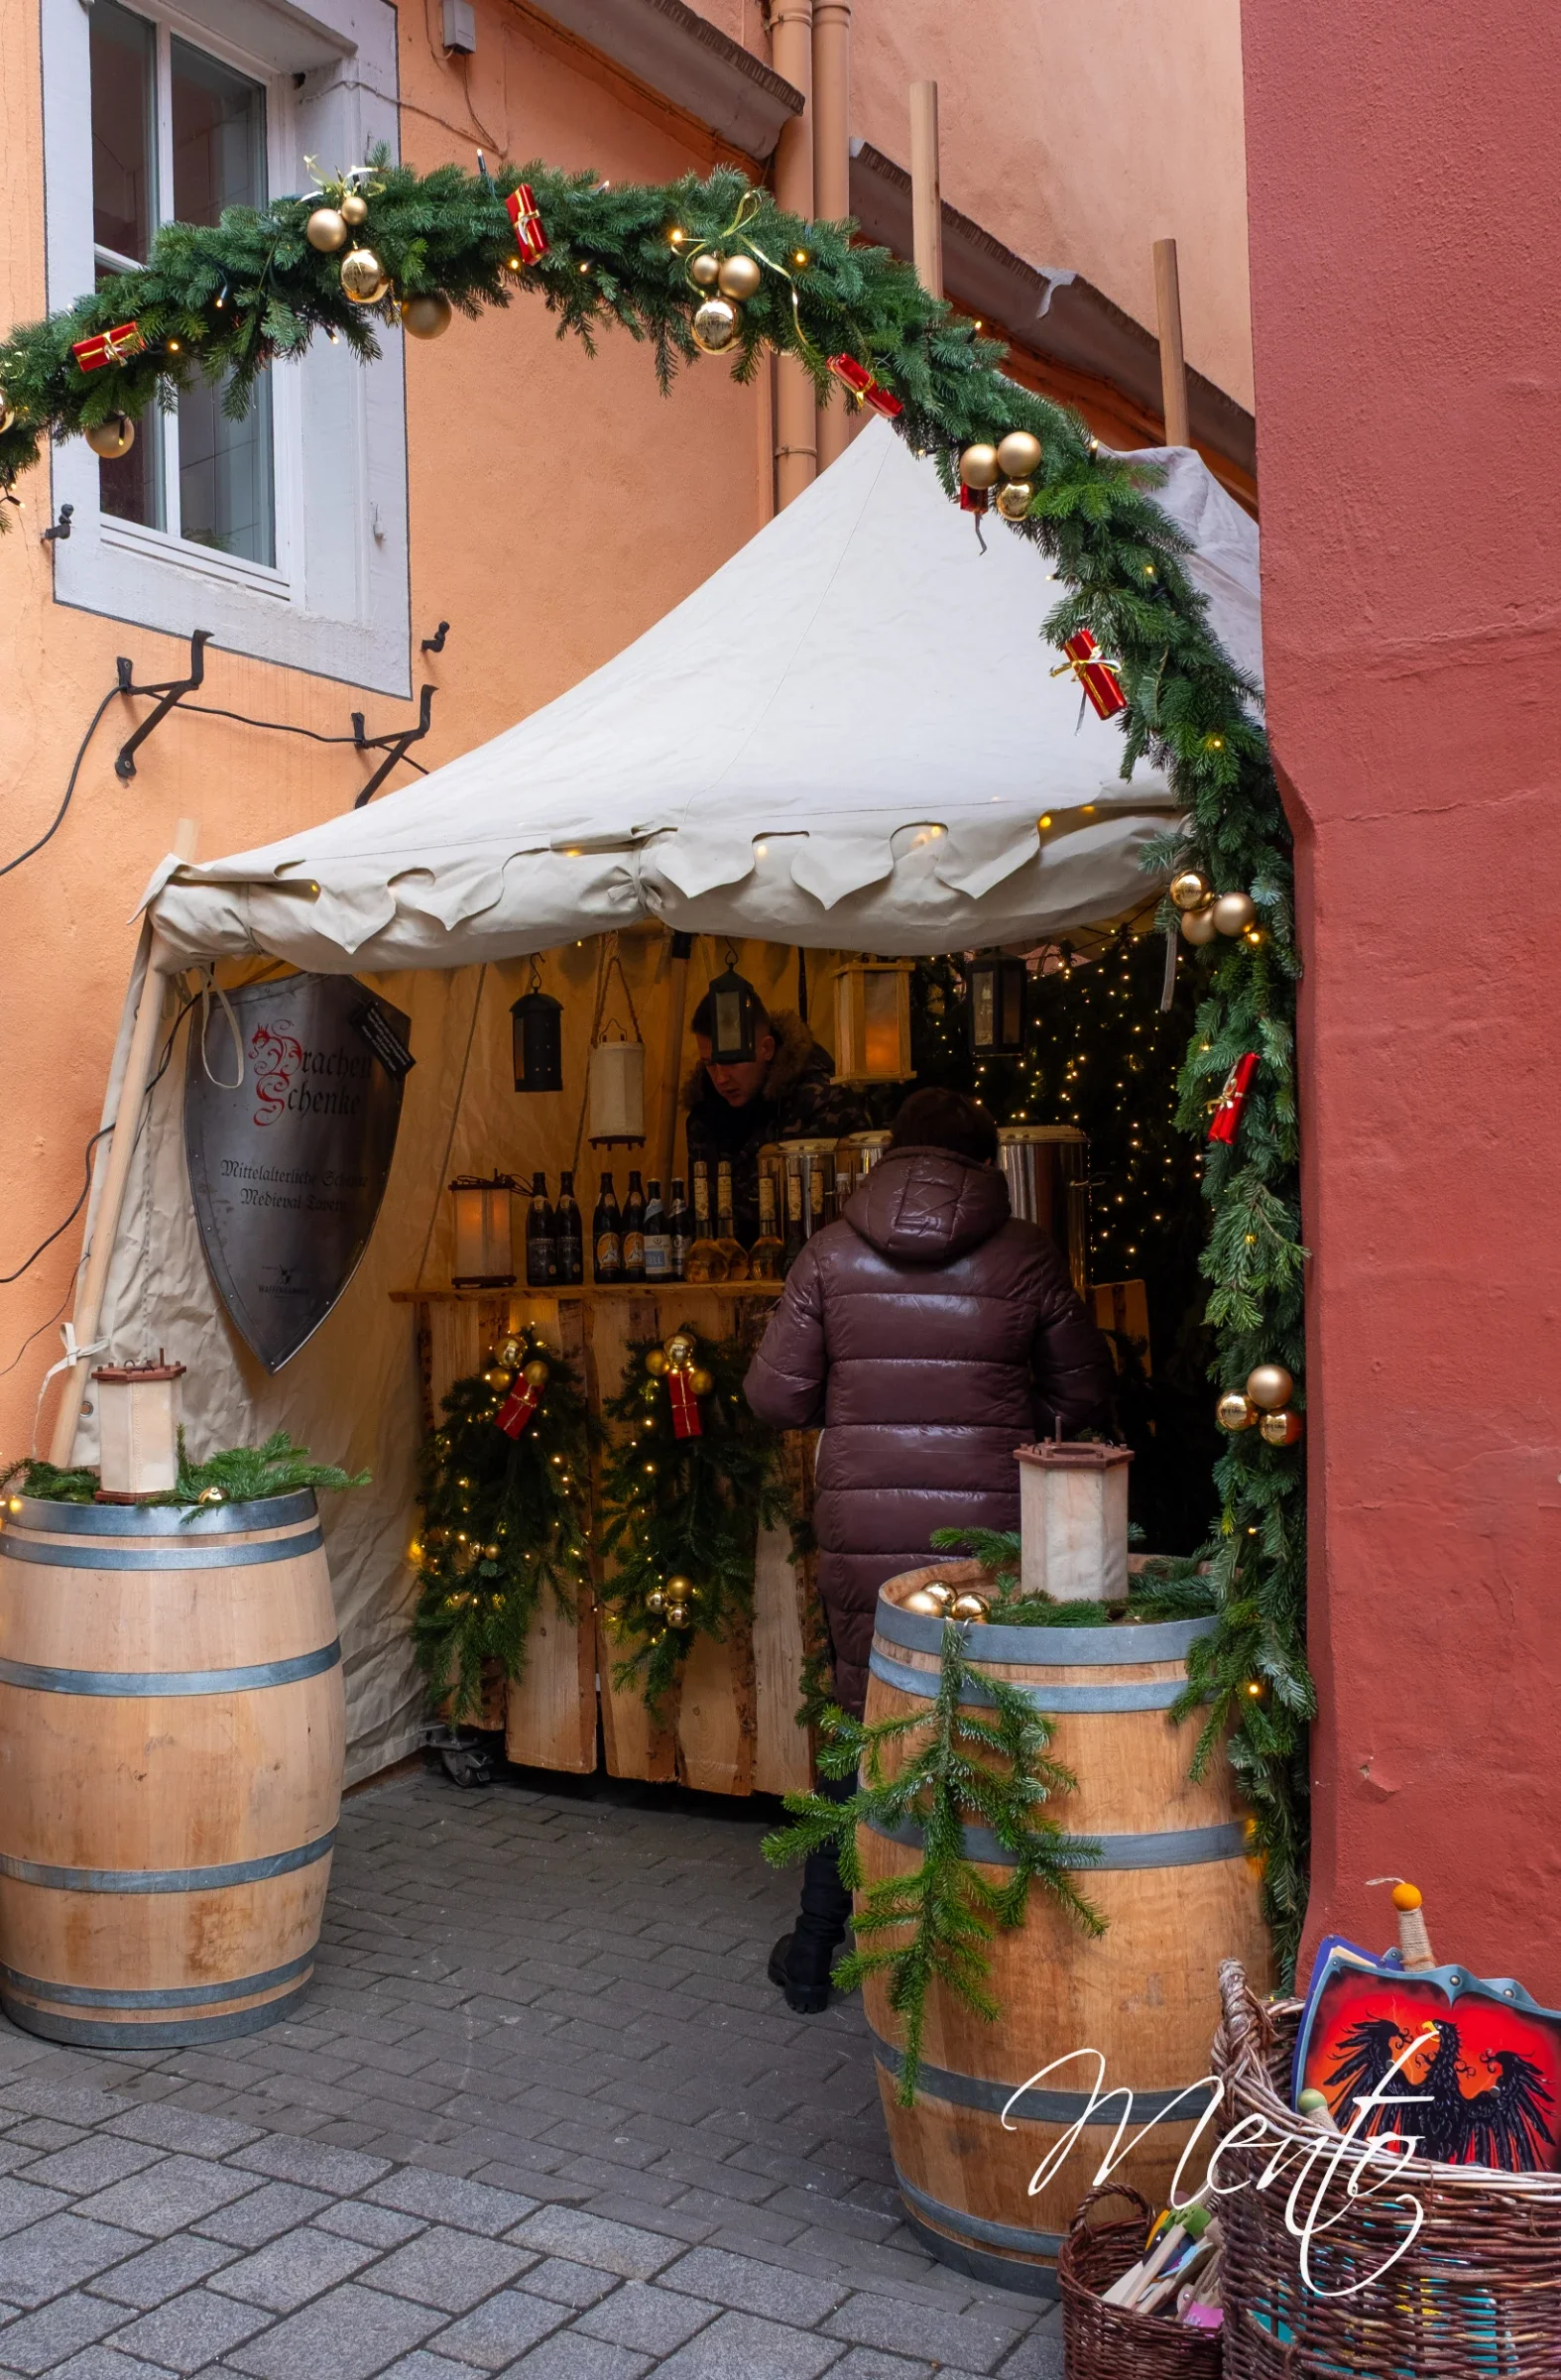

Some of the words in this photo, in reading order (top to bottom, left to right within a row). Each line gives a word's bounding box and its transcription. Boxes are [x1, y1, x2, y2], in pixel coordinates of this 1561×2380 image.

[248, 1019, 372, 1081] Drachen
[253, 1073, 361, 1127] Schenke
[220, 1159, 317, 1188] Mittelalterliche
[240, 1187, 301, 1209] Medieval
